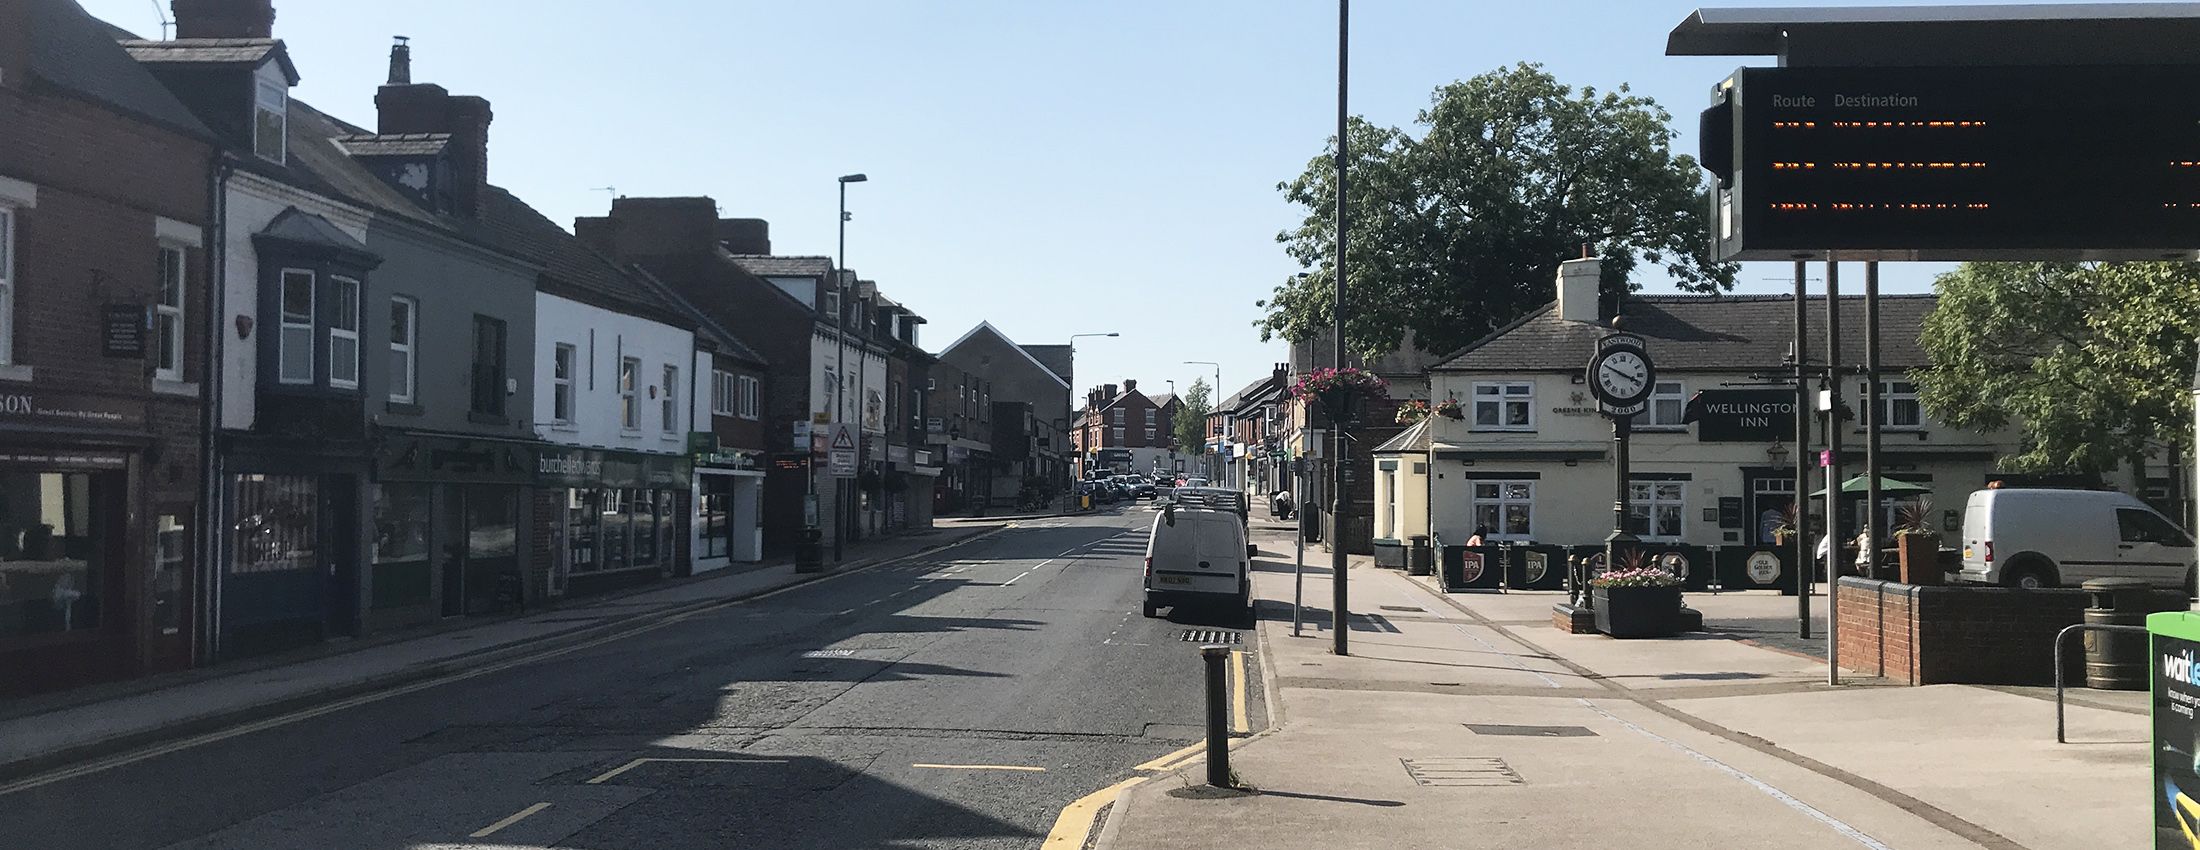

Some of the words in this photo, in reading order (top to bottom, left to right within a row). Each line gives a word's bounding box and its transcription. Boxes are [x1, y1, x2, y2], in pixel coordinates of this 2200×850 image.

[1773, 94, 1815, 107] Route
[1834, 93, 1918, 107] Destination
[1740, 416, 1767, 426] INN
[1464, 561, 1479, 569] IPA
[1527, 561, 1542, 569] IPA
